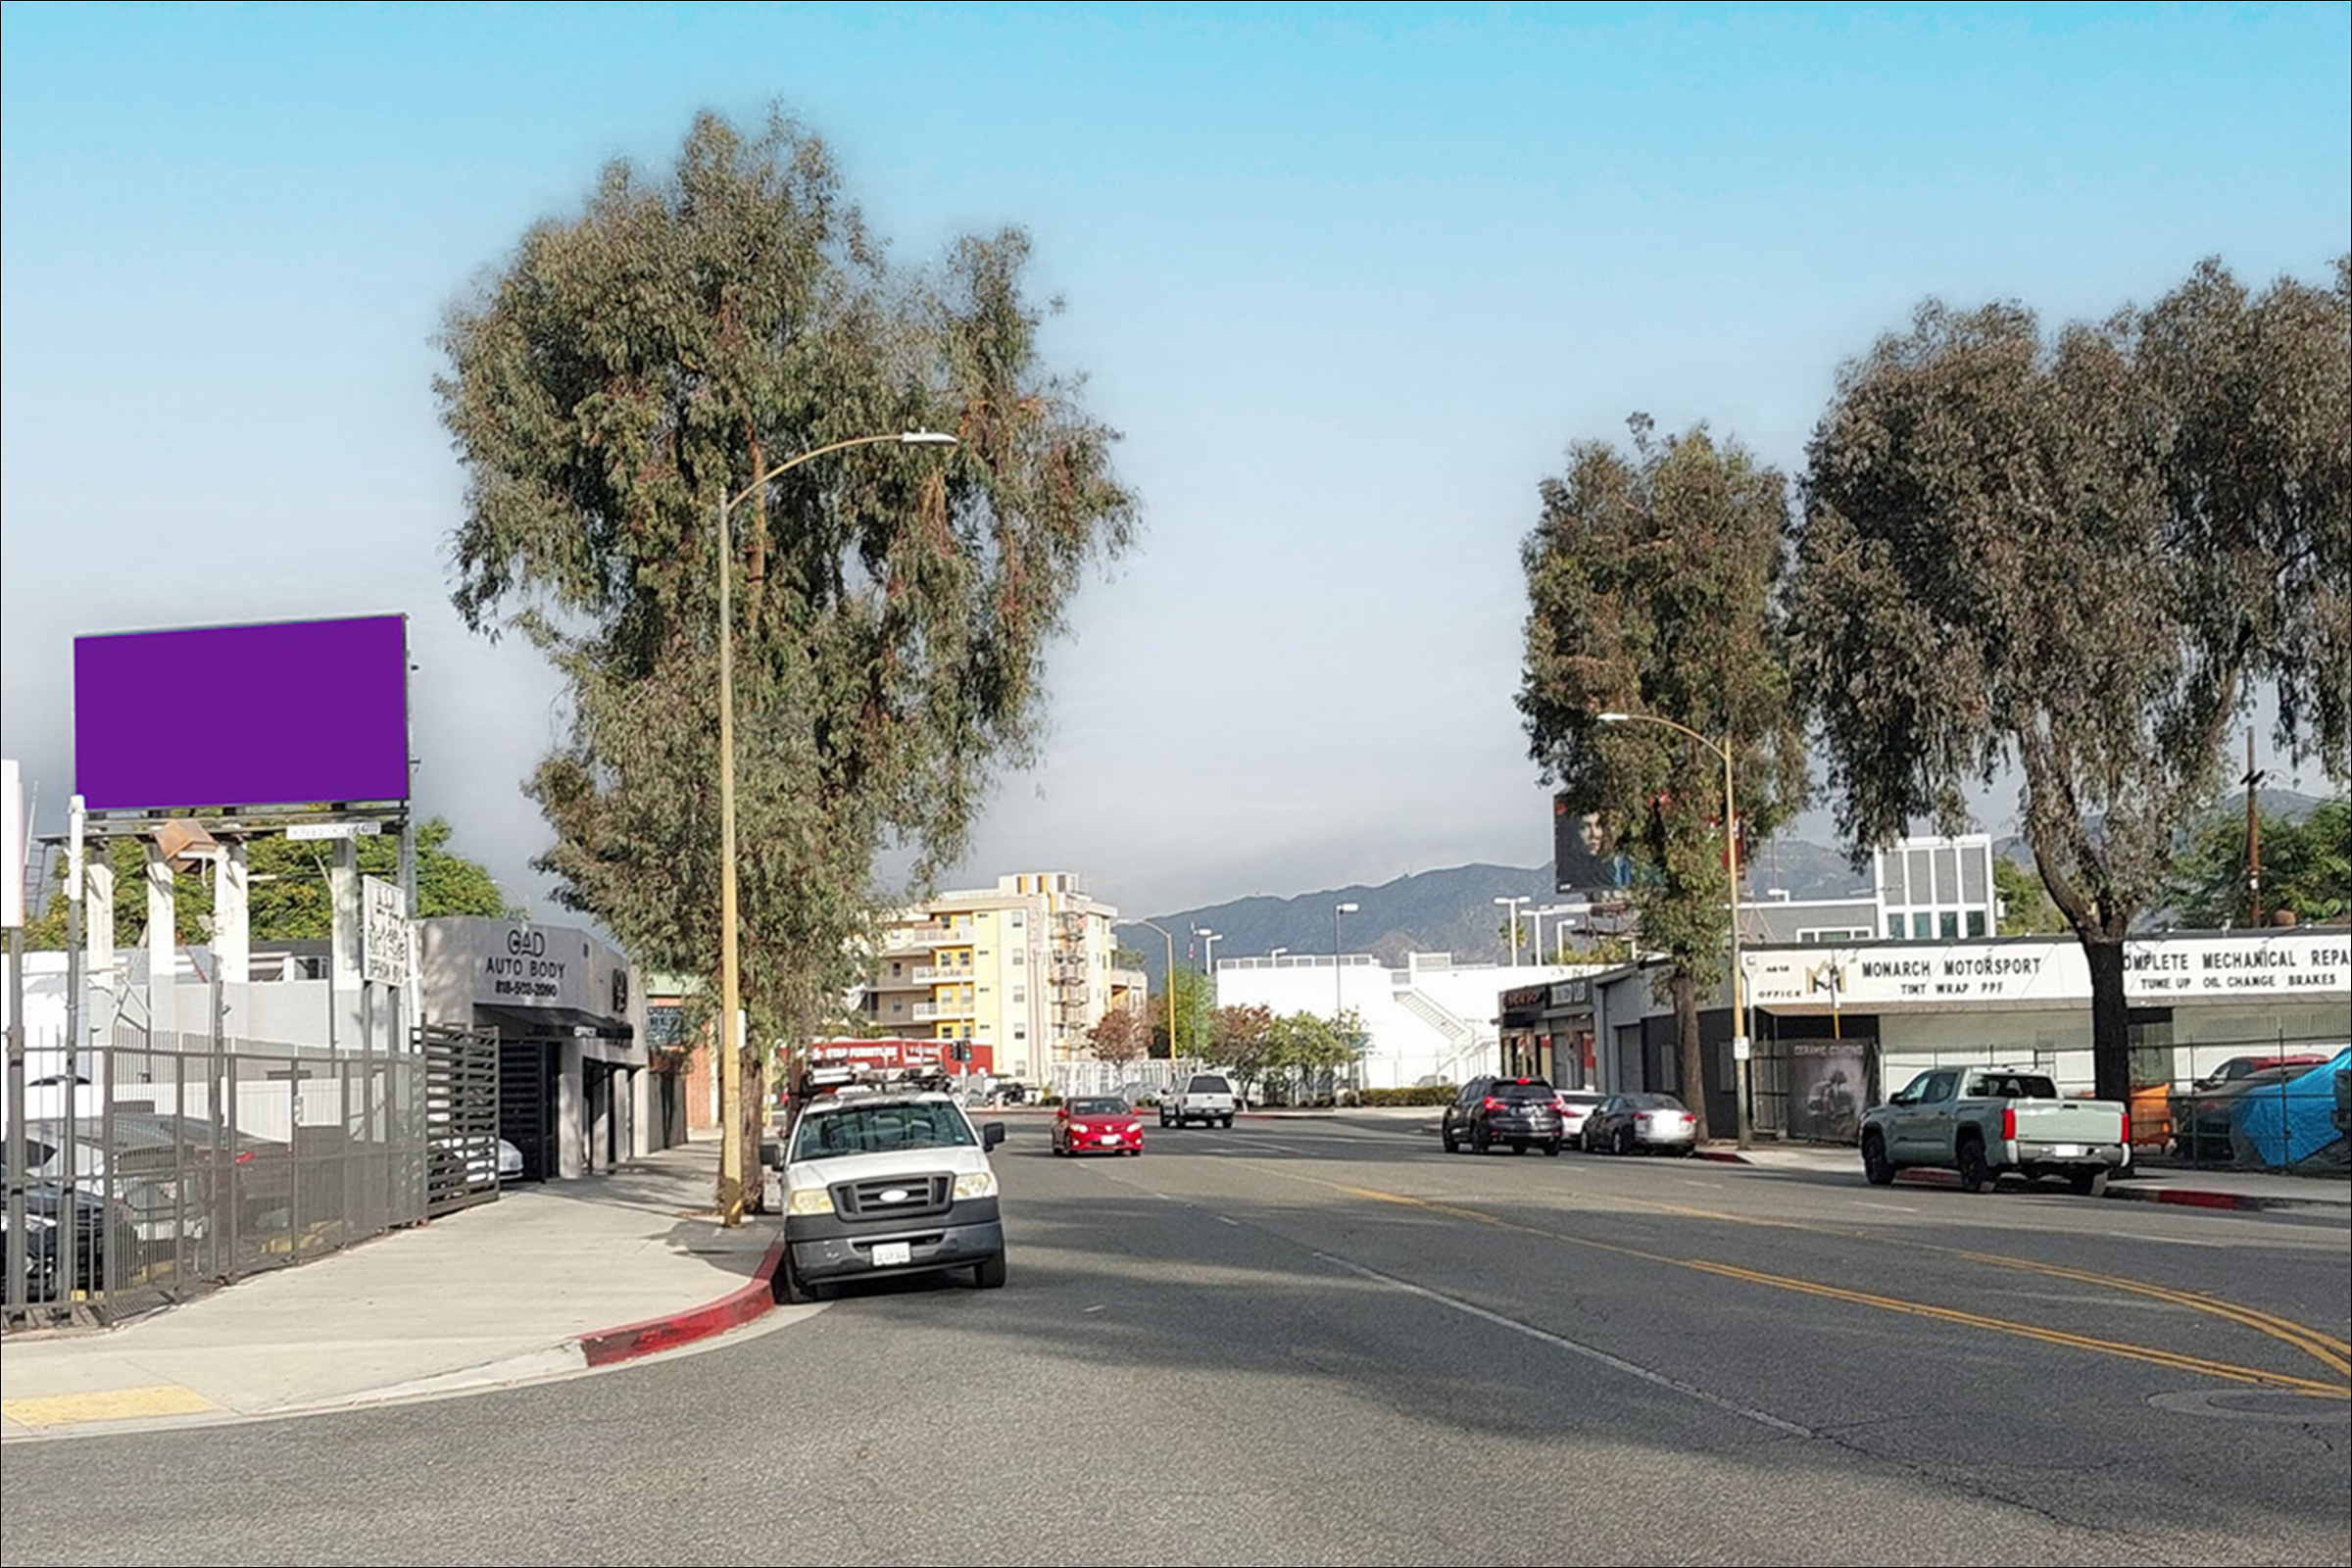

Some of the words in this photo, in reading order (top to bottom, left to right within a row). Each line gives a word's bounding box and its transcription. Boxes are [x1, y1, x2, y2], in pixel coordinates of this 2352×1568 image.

[507, 929, 546, 957] GAD
[486, 956, 523, 976] AUTO
[529, 959, 565, 979] BODY
[1862, 960, 1931, 978] MONARCH
[1944, 957, 2040, 976] MOTORSPORT
[2123, 953, 2189, 972] OMPLETE
[2202, 951, 2296, 970] MECHANICAL
[2311, 949, 2351, 966] REPA
[1900, 983, 1927, 996] TINT
[1936, 983, 1969, 995] WRAP
[1981, 981, 2003, 994] PPF
[2140, 977, 2172, 991] TUNE
[2176, 977, 2191, 989] UP
[2203, 976, 2223, 989] OIL
[2227, 975, 2276, 988] CHANGE
[2287, 973, 2336, 986] BRAKES
[1757, 990, 1802, 999] OFFICE
